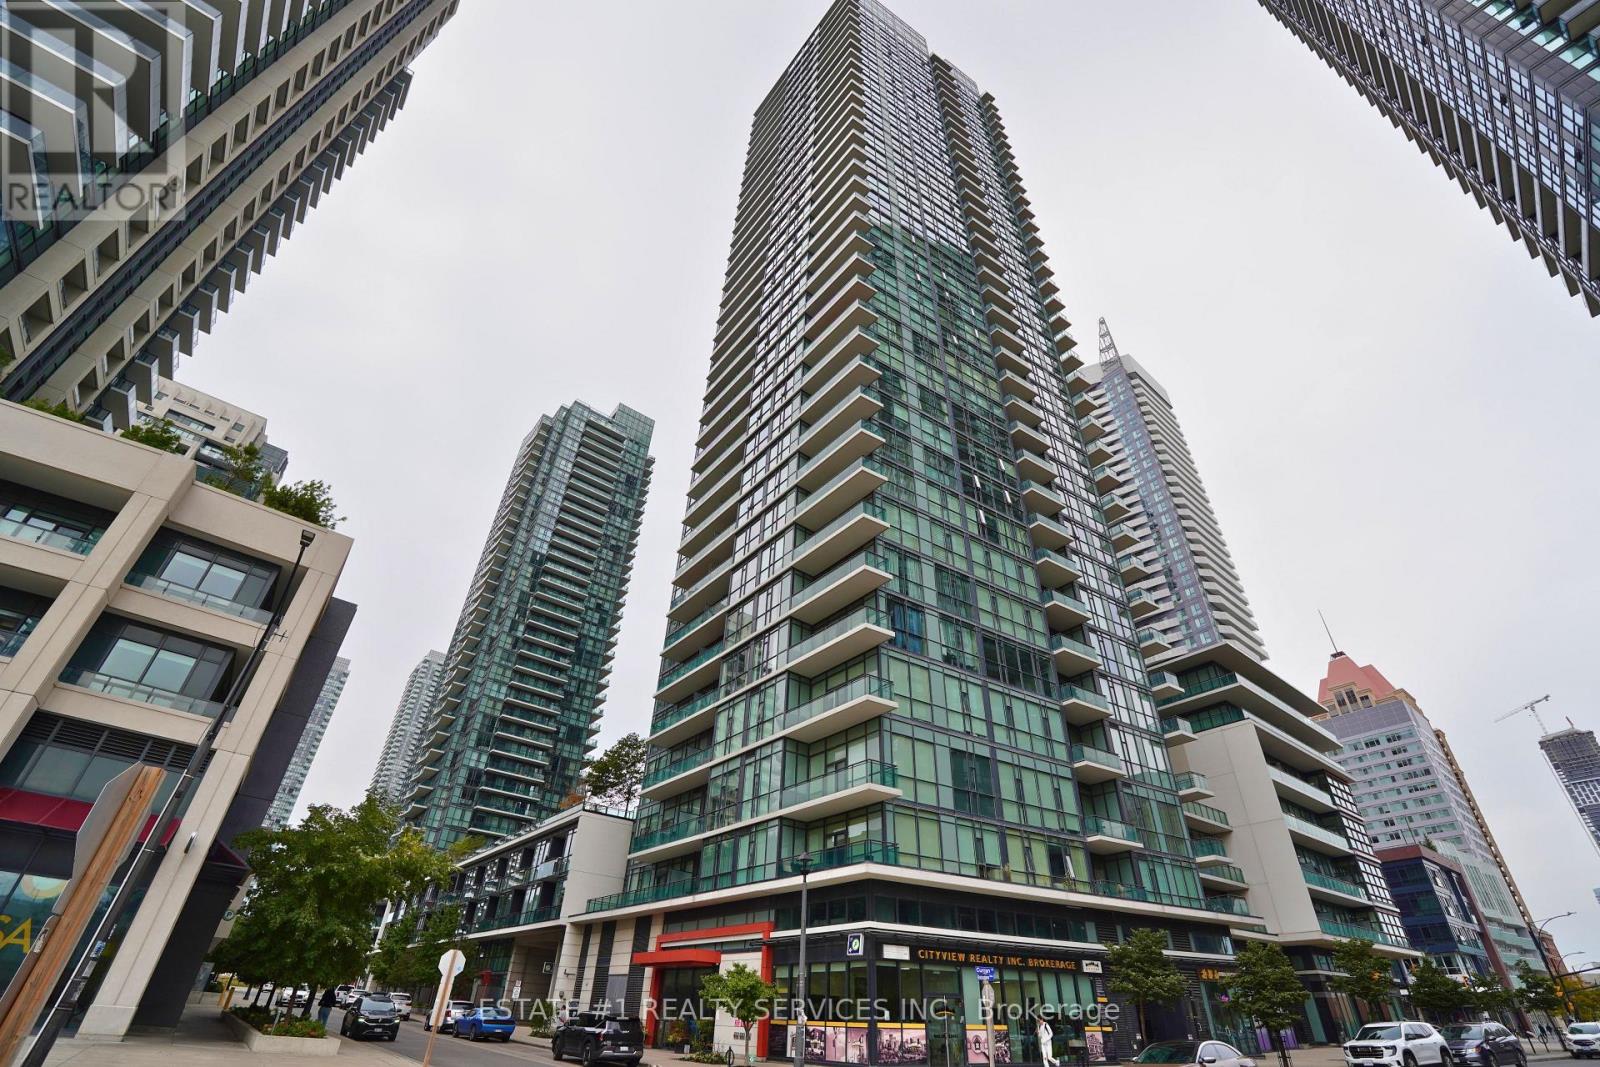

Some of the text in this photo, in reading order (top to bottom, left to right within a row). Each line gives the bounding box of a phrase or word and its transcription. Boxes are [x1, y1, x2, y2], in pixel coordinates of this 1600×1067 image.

[918, 949, 965, 962] CITYVIEW
[969, 953, 1003, 965] REALTY
[1007, 957, 1025, 966] INC.
[1028, 958, 1076, 970] BROKERAGE
